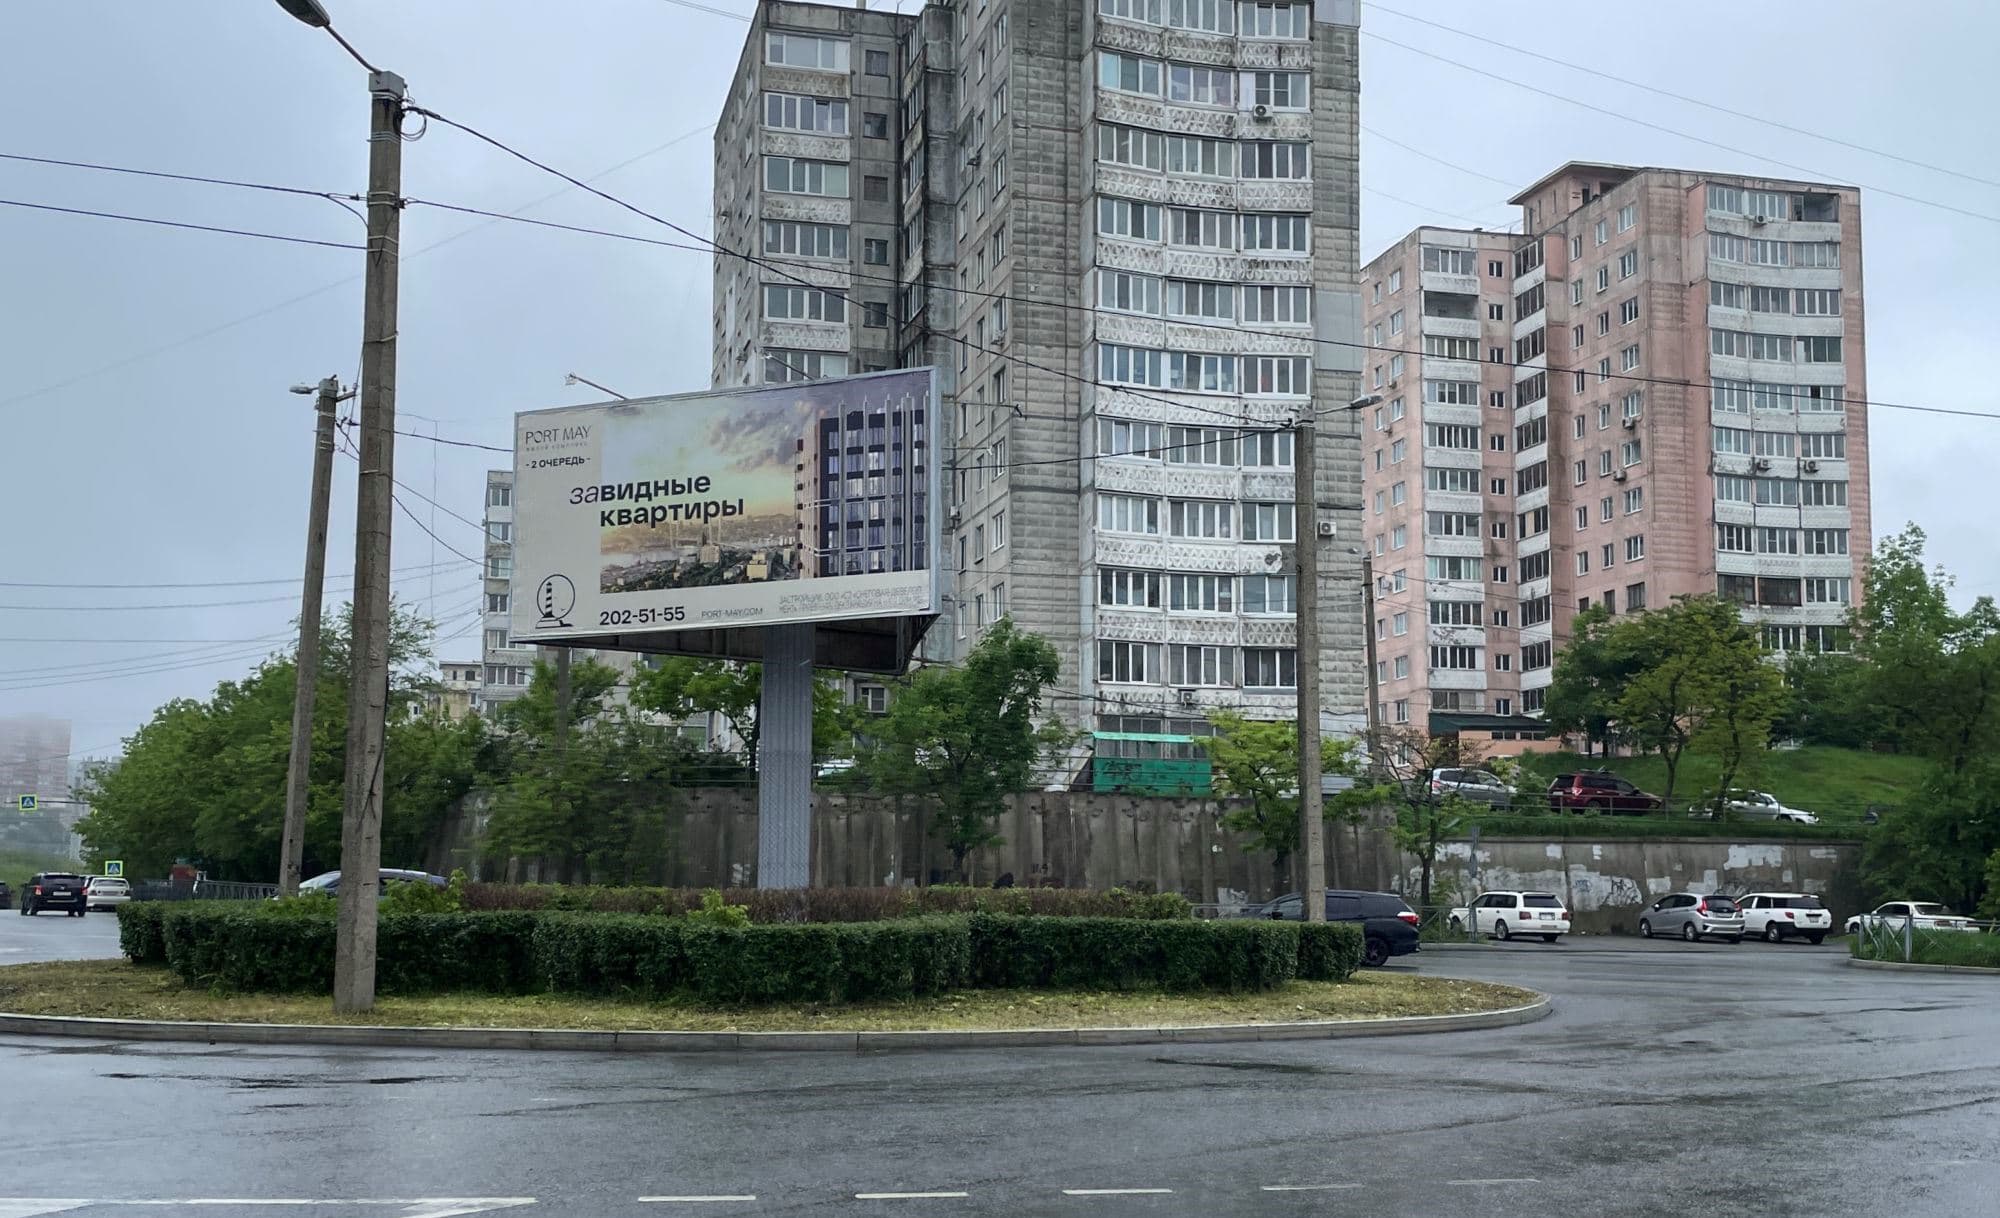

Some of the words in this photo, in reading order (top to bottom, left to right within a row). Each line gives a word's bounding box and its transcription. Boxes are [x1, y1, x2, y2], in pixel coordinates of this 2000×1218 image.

[525, 428, 560, 445] PORT
[562, 424, 592, 441] MAY
[538, 455, 585, 468] ОЧЕРЕДЬ
[569, 475, 711, 505] завидные
[600, 498, 744, 529] квартиры
[600, 606, 686, 626] 202-51-55
